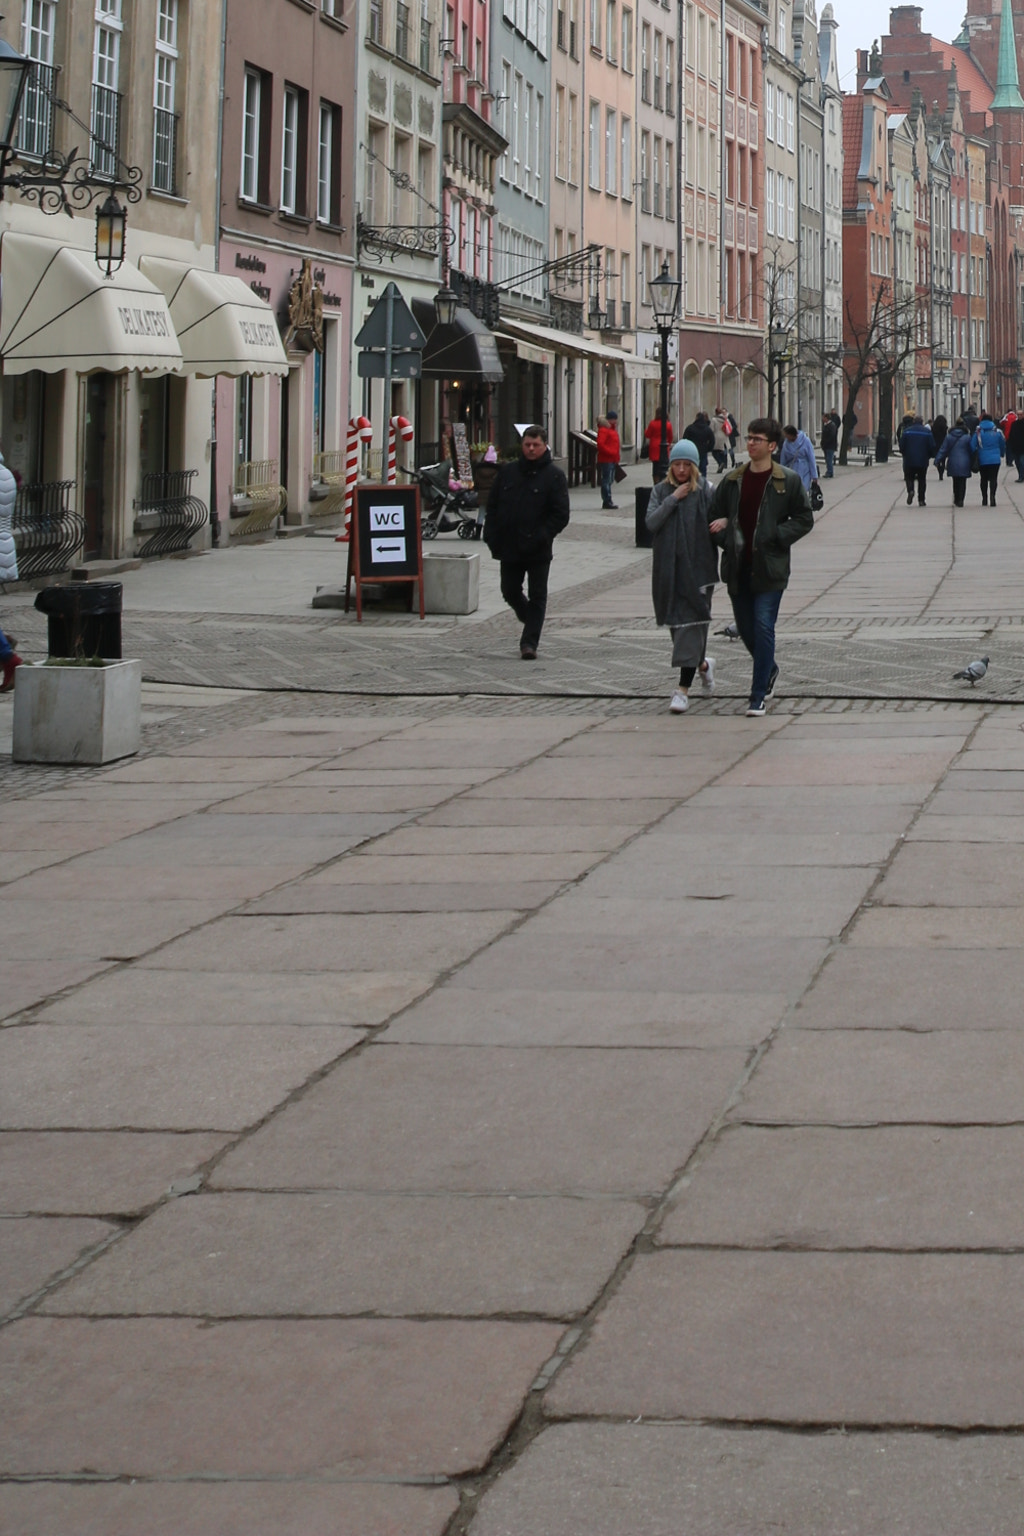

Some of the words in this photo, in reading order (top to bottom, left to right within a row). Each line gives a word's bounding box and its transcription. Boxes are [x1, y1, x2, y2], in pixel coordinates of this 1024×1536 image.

[118, 307, 171, 337] DELIKATESY
[238, 320, 278, 347] DELIKATESY
[374, 512, 400, 525] WC
